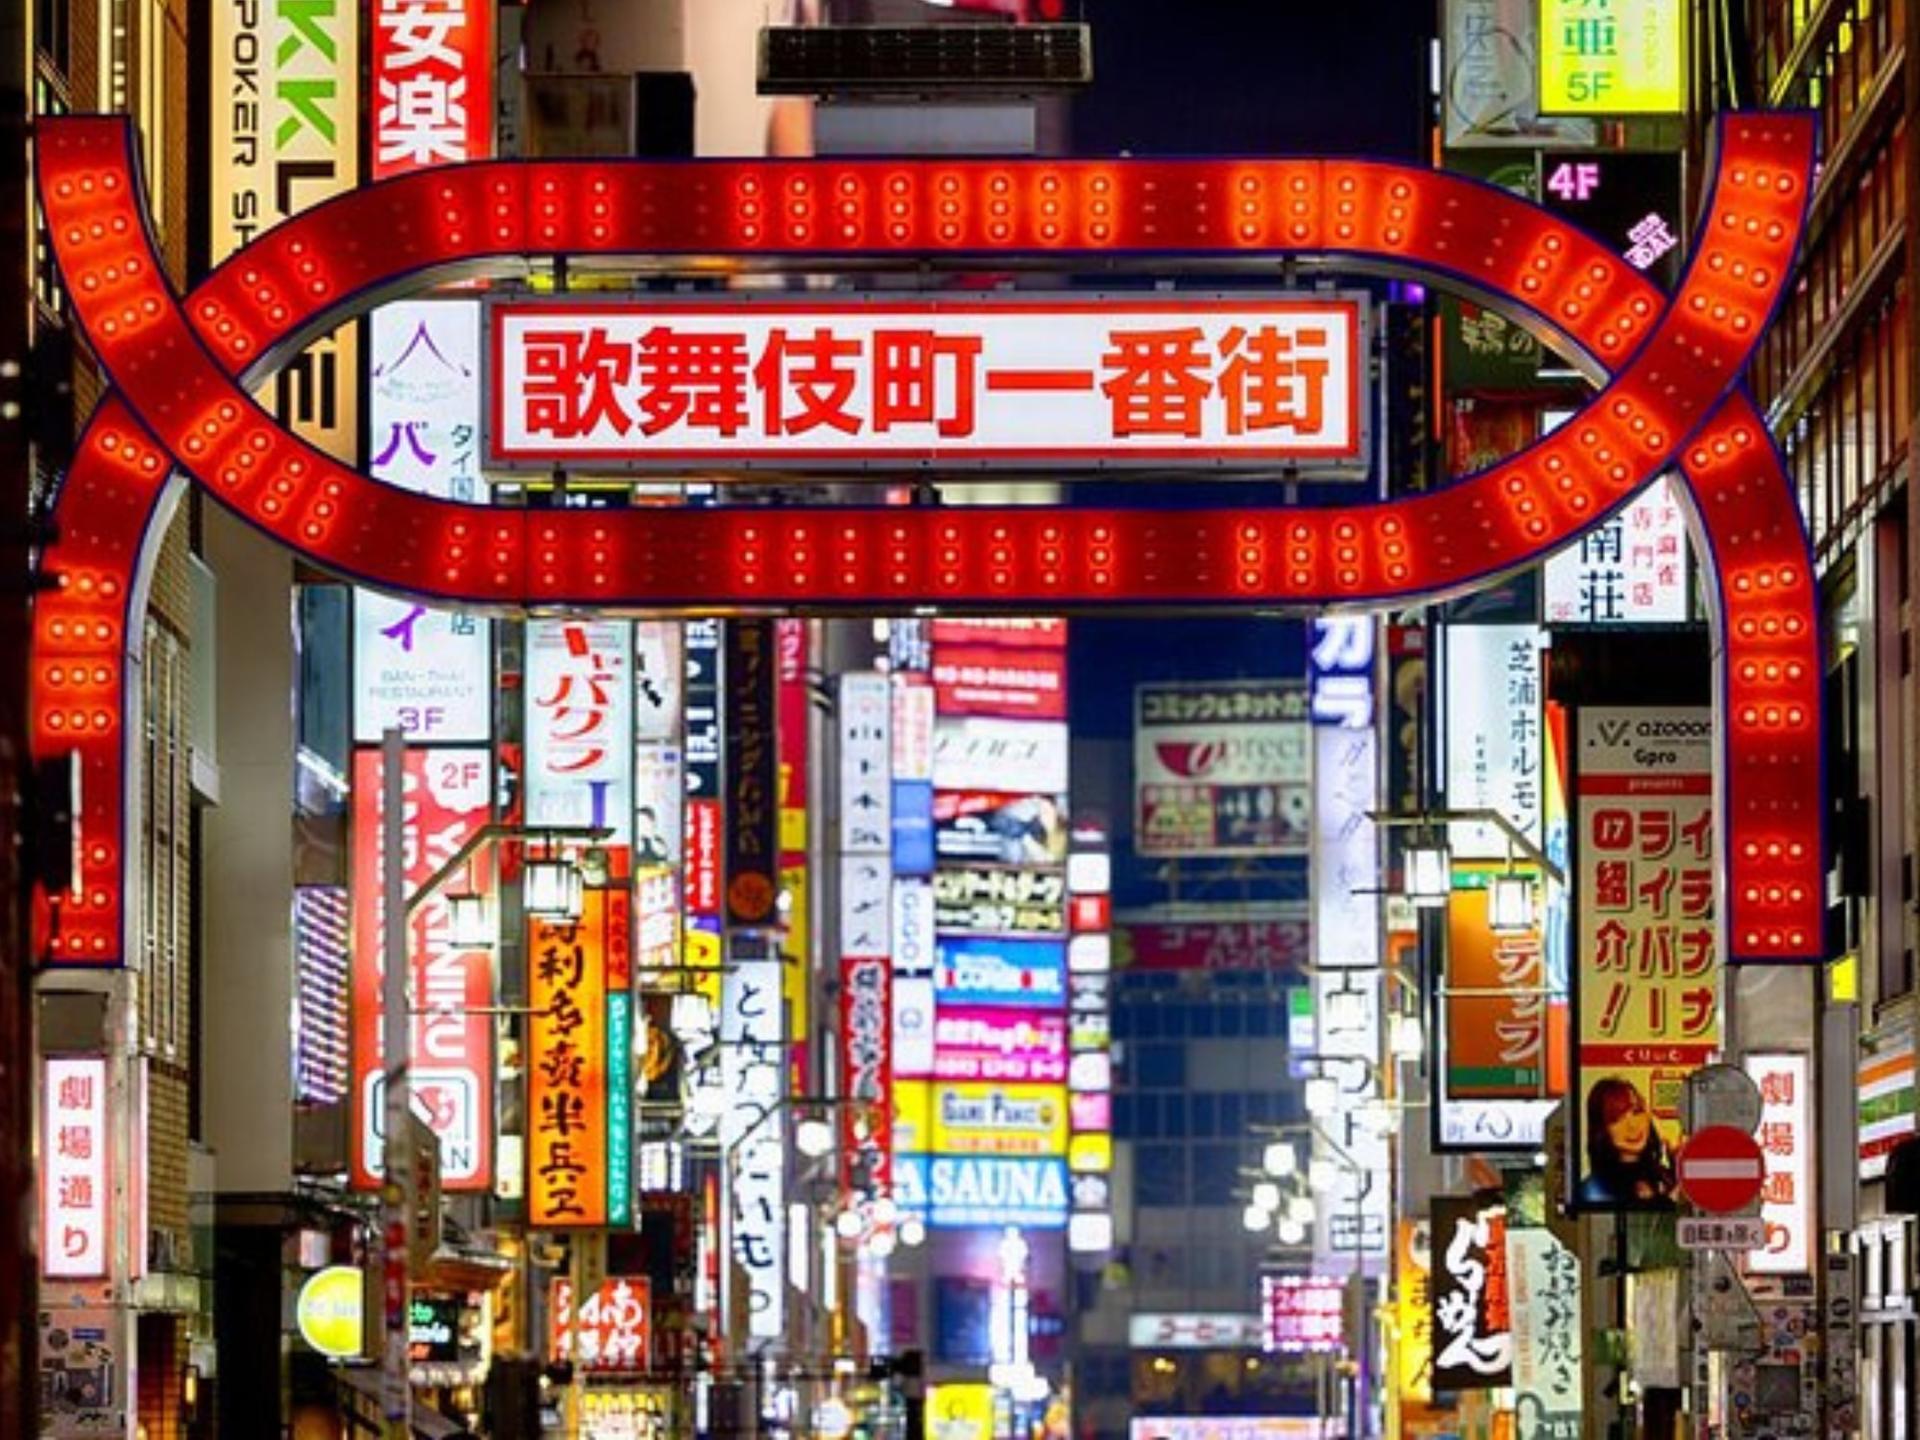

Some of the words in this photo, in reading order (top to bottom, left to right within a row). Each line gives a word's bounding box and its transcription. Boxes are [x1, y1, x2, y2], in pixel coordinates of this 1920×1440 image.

[232, 0, 258, 167] POKER
[378, 0, 467, 164] 安楽
[1566, 72, 1613, 102] 5F
[1548, 163, 1600, 200] 4F
[521, 326, 1328, 439] 歌舞伎町一番街
[398, 706, 445, 733] 3F
[1312, 618, 1373, 728] カラ
[440, 761, 481, 790] 2F
[1508, 638, 1538, 833] 芝浦ホルモン
[1633, 749, 1678, 768] Gpro
[1639, 810, 1674, 1031] ライバー
[58, 1075, 93, 1258] 劇場通り
[931, 1159, 1067, 1207] SAUNA
[1760, 1070, 1795, 1255] 劇場通り
